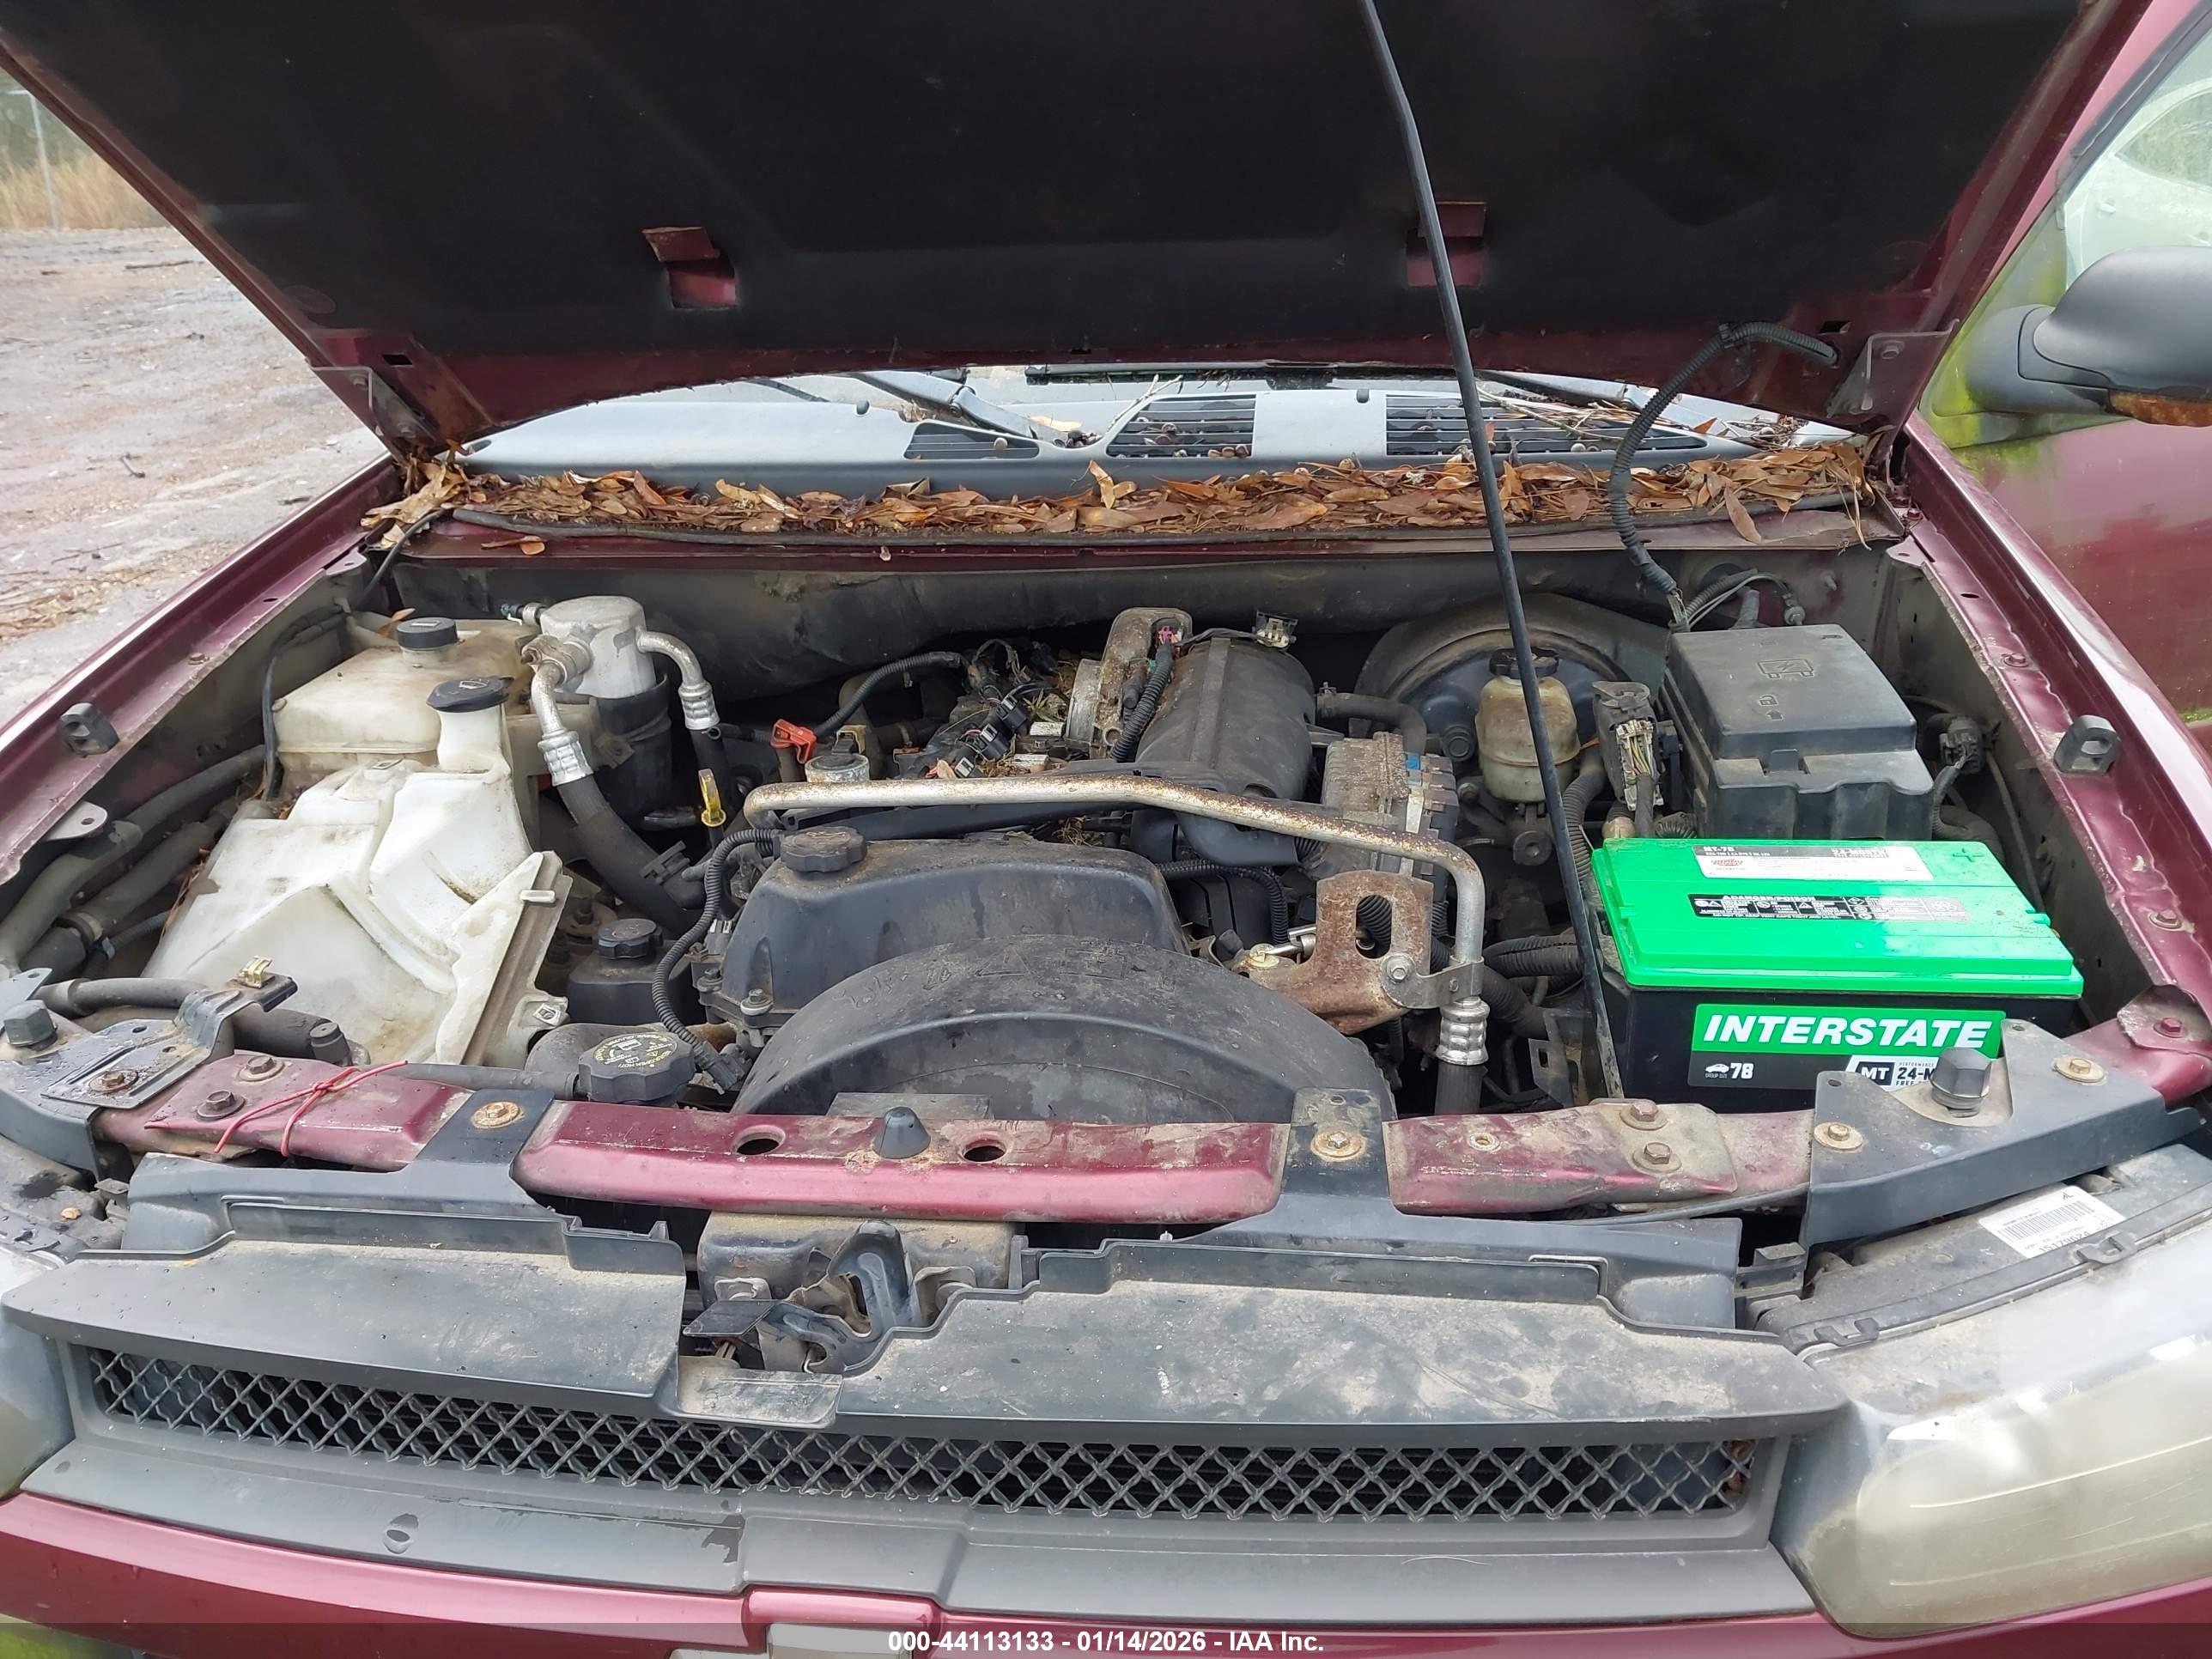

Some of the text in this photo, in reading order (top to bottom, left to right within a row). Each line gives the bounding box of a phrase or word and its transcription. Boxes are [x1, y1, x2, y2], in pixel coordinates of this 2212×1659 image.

[1703, 1014, 1993, 1048] INTERSTATE
[1730, 1062, 1754, 1079] 78
[1861, 1066, 1889, 1080] MT
[1897, 1066, 1936, 1080] 24-M
